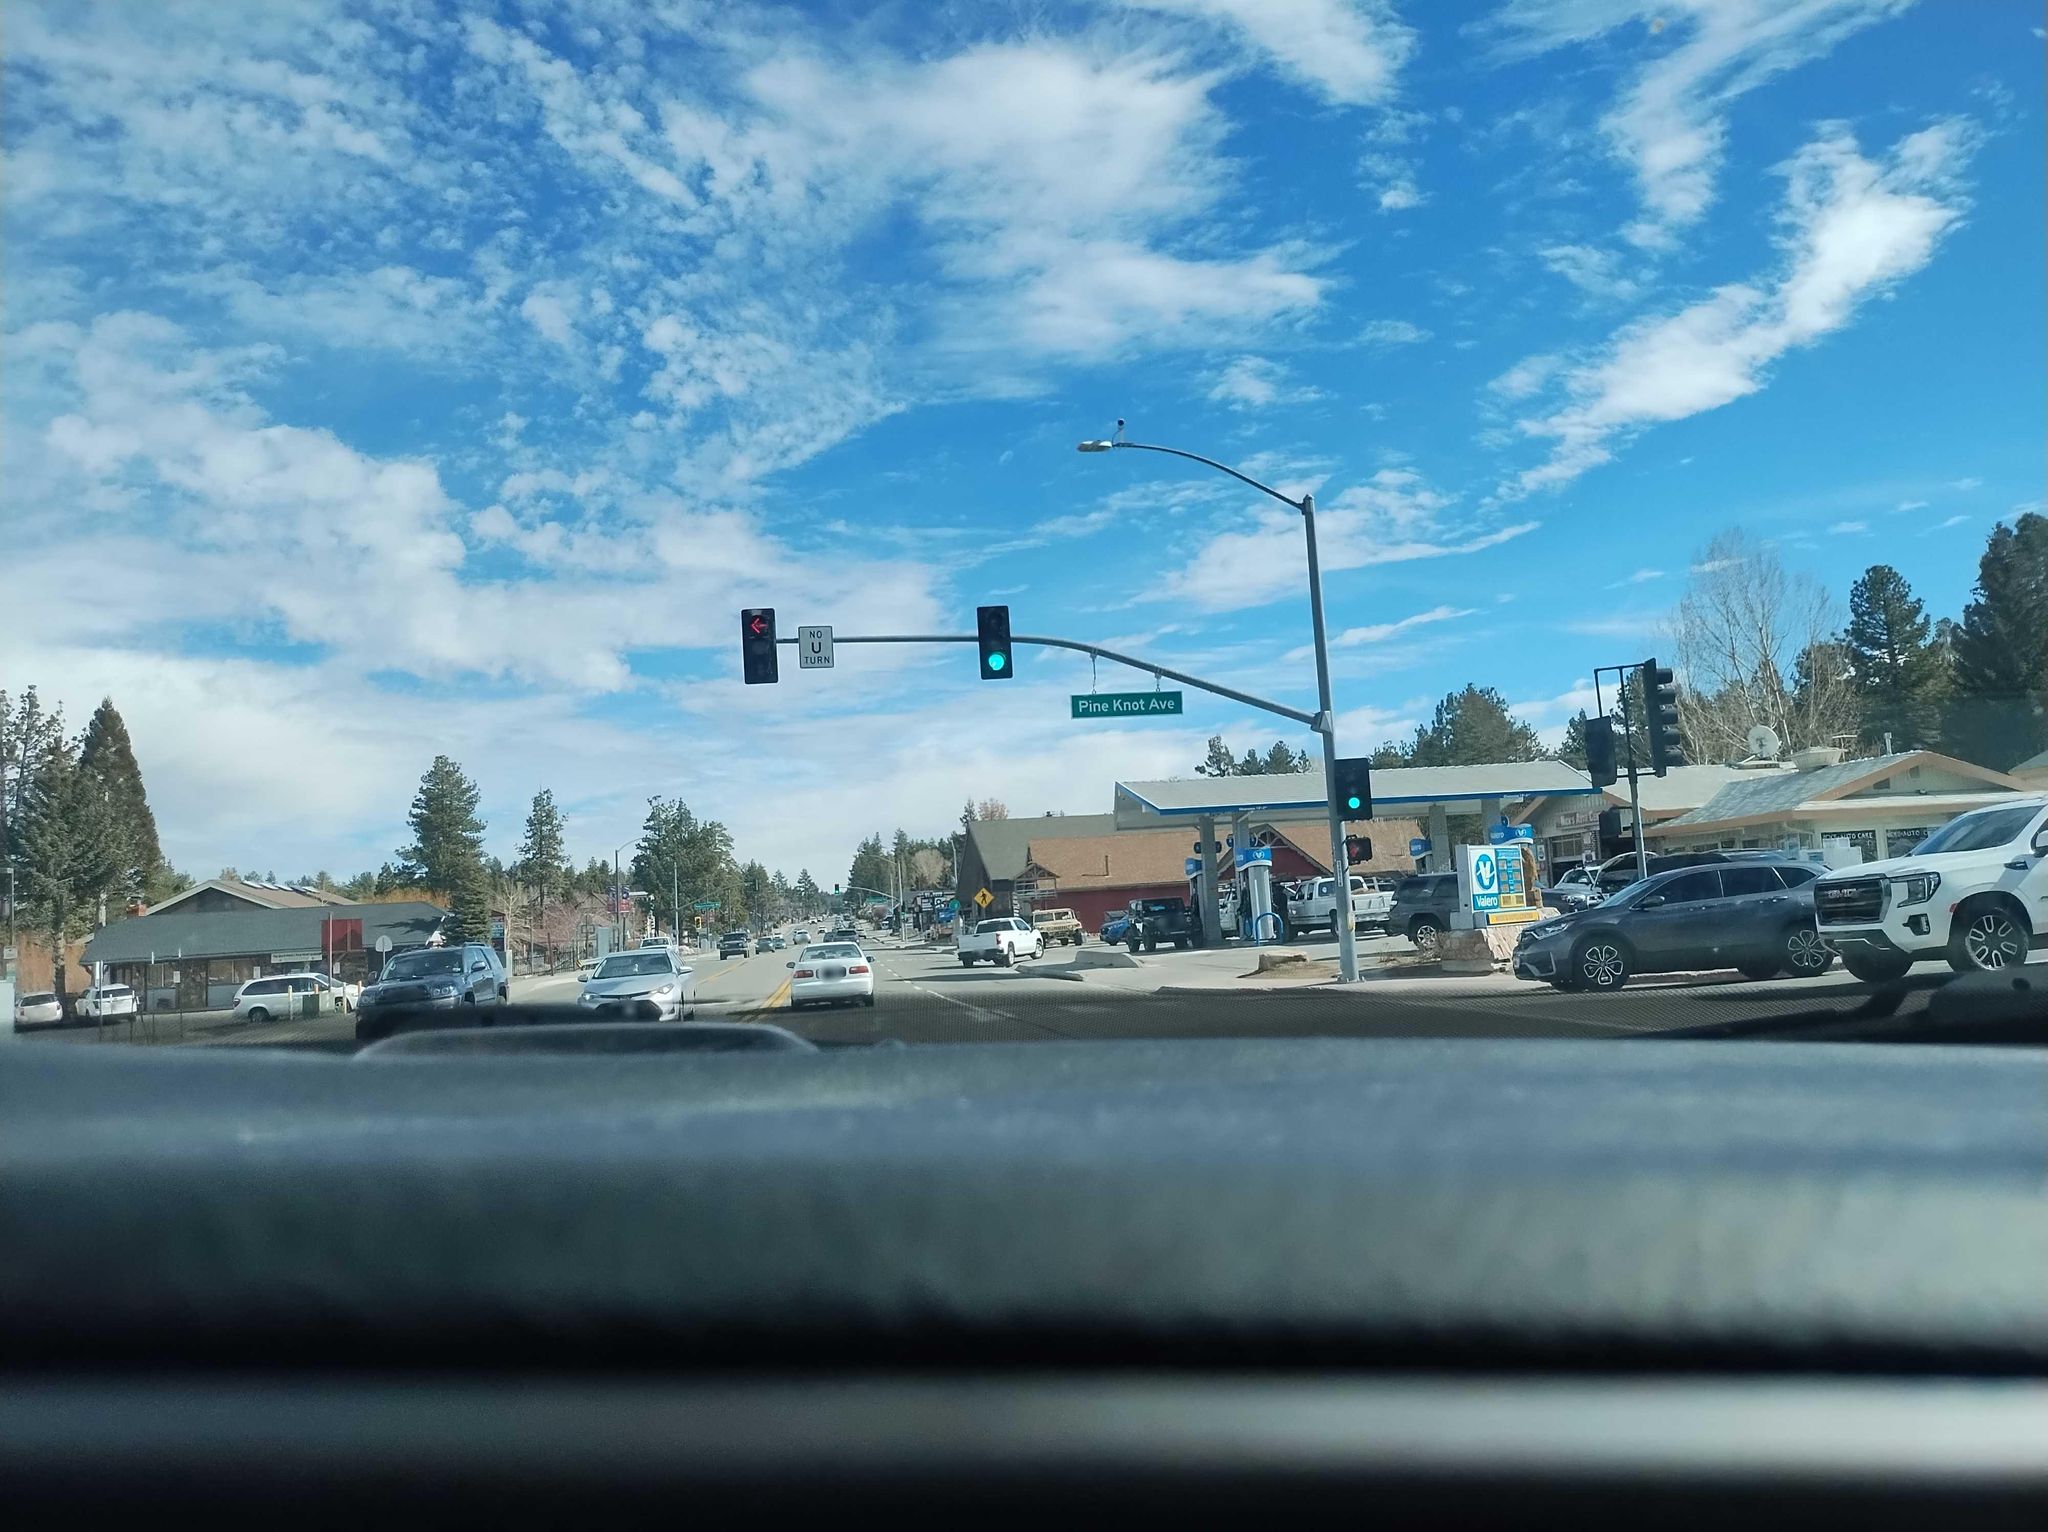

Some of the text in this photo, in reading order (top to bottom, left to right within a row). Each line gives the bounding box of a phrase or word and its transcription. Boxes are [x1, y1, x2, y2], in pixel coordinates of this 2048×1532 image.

[809, 630, 823, 639] NO
[811, 641, 822, 654] U
[804, 656, 830, 664] TURN
[1078, 698, 1175, 713] Pine Knot Ave
[1476, 895, 1498, 907] Valero
